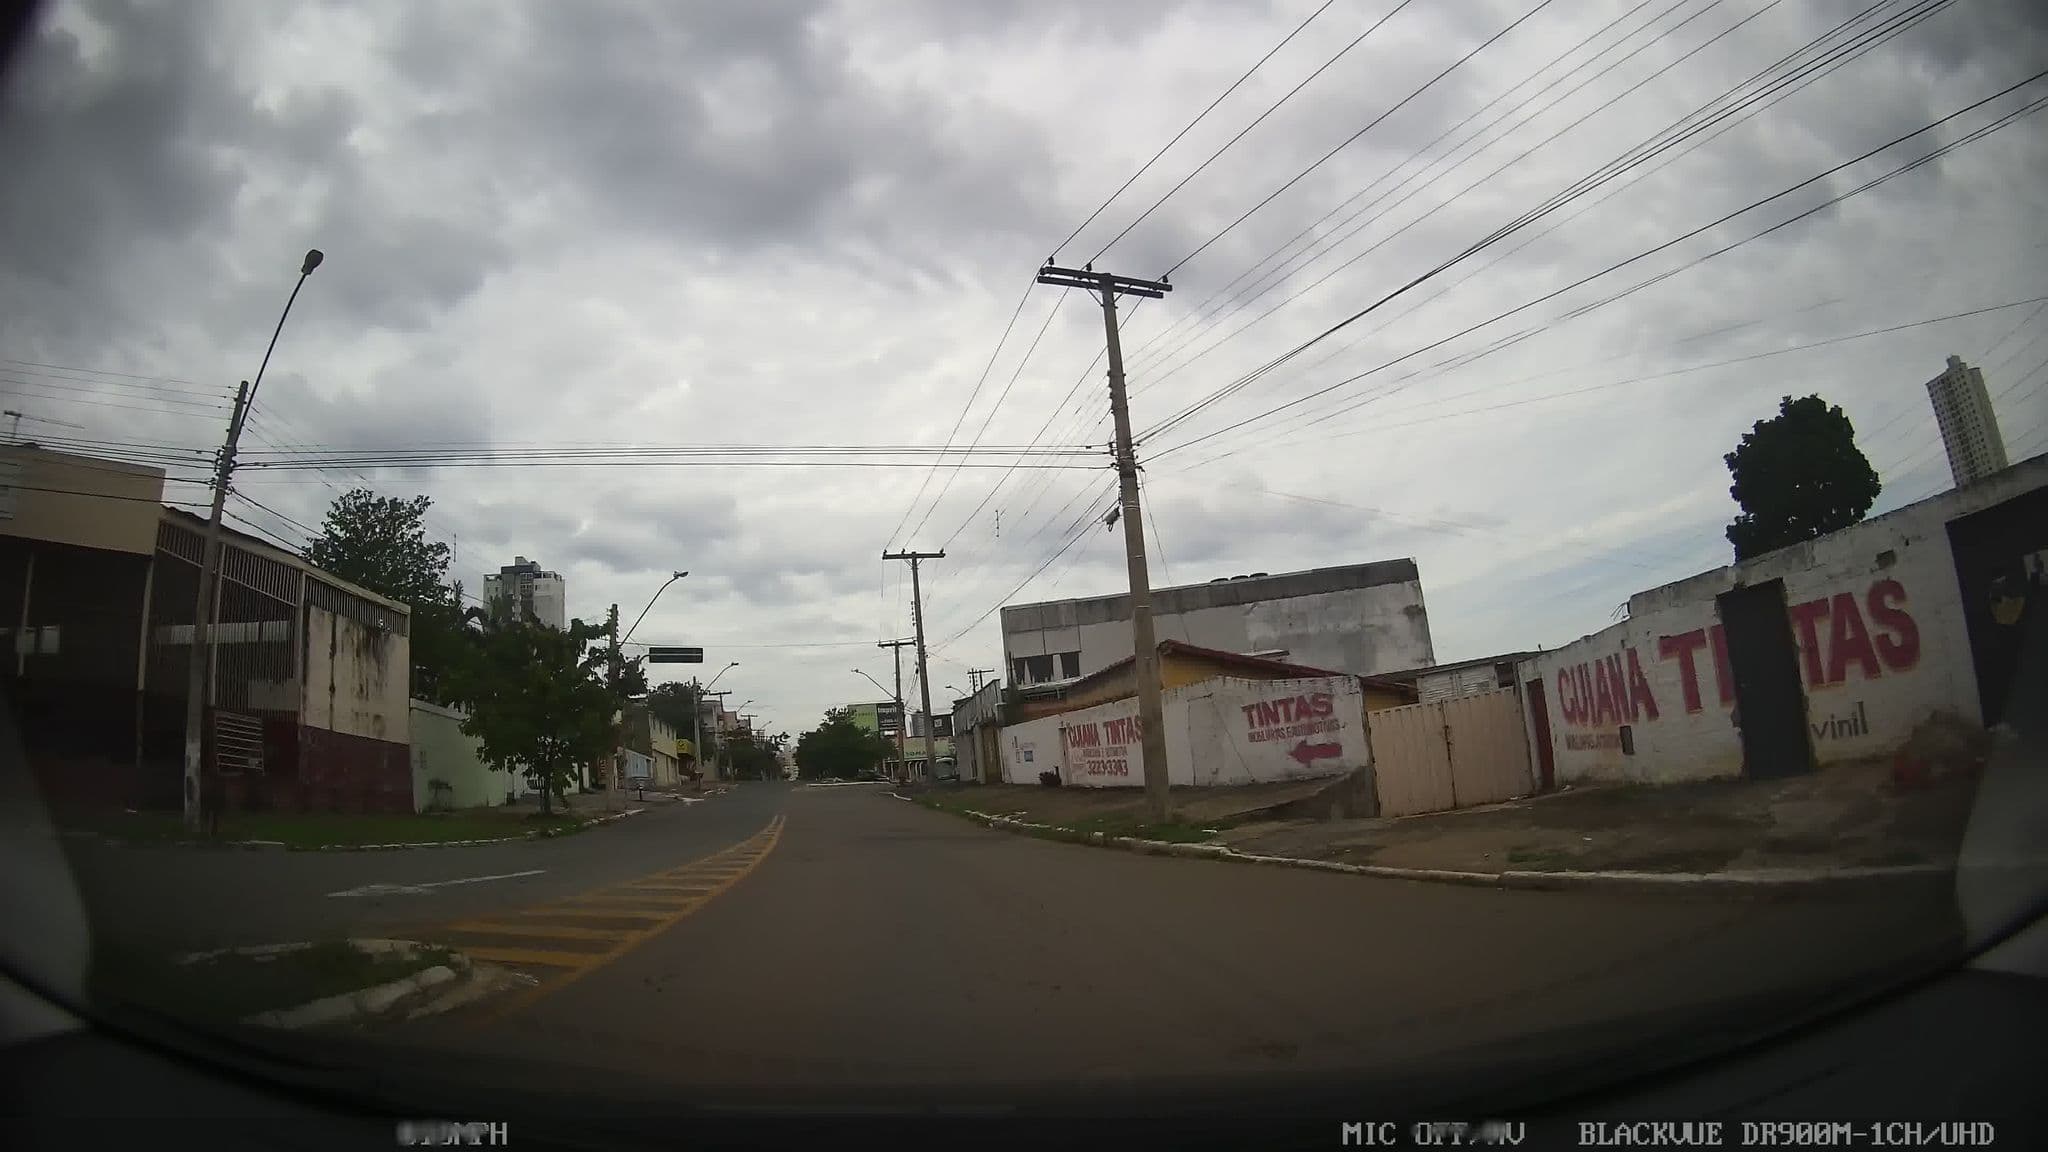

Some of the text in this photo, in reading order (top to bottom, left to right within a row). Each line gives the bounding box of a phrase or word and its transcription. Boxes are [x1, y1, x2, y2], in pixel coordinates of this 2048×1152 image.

[1658, 578, 1920, 713] TITAS
[1241, 693, 1334, 729] TINTAS
[1103, 716, 1144, 745] TINTAS
